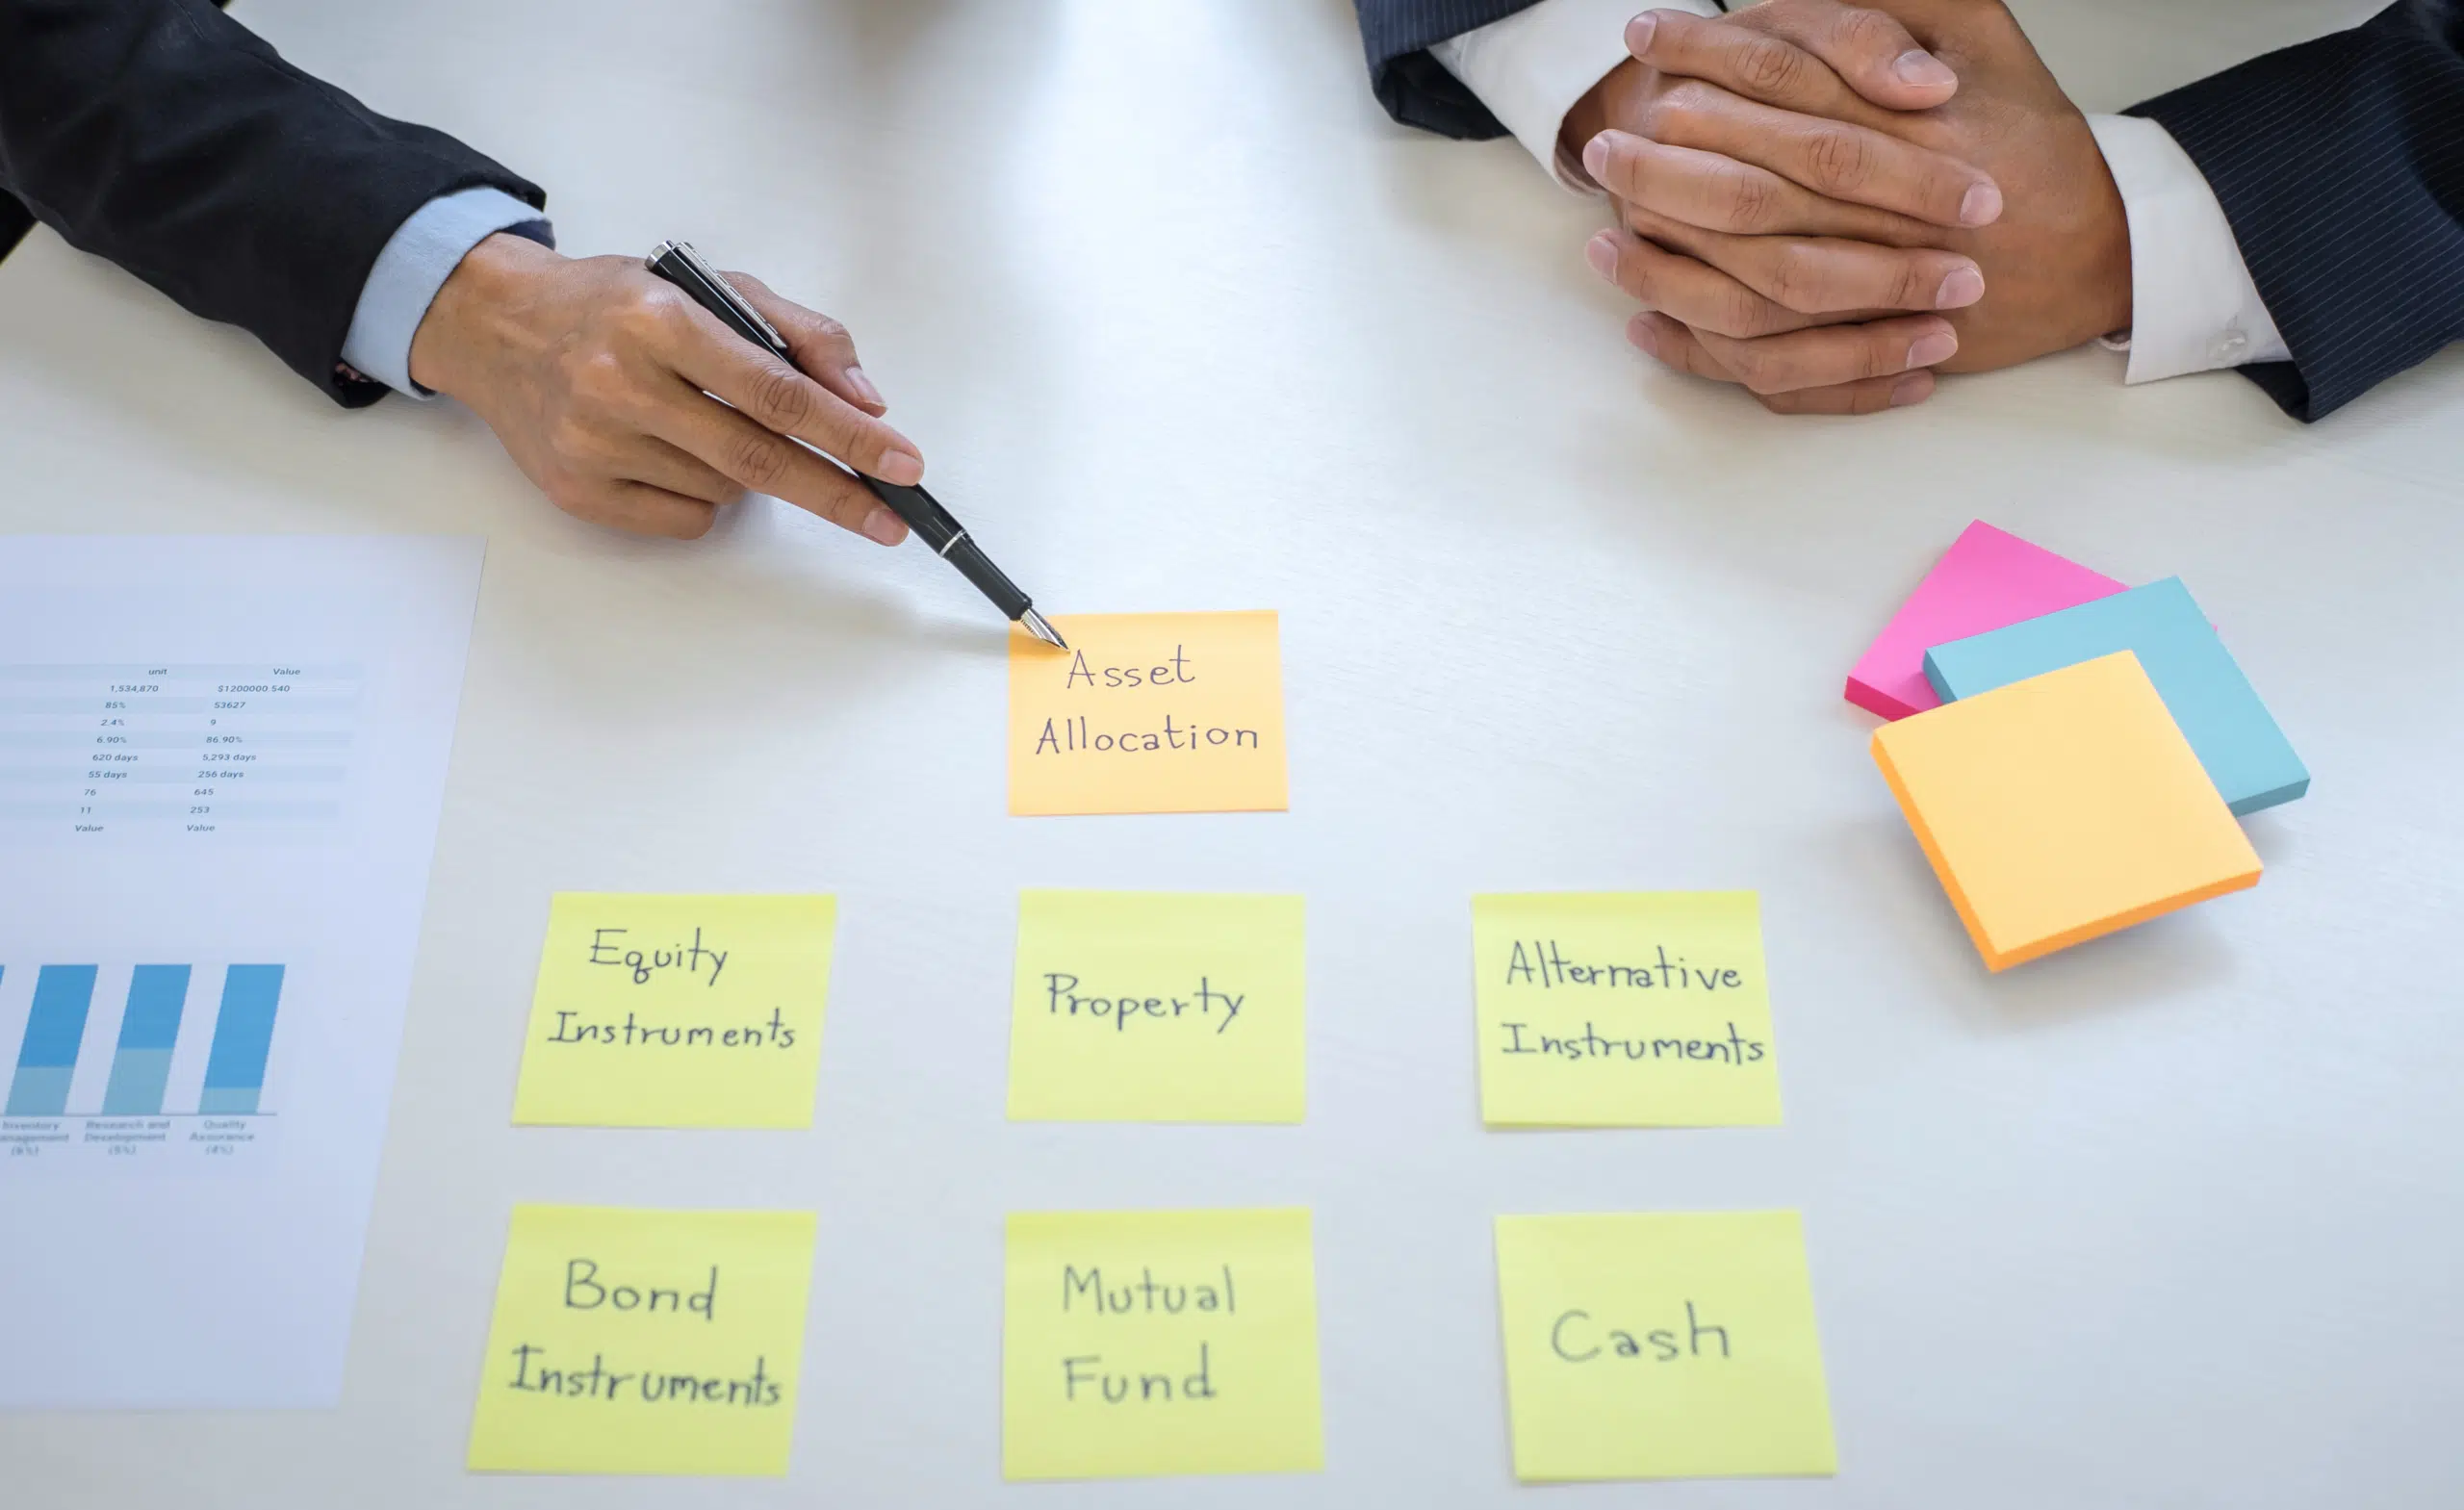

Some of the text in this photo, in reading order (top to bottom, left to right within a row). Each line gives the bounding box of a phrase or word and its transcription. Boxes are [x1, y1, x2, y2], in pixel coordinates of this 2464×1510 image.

[1065, 643, 1196, 690] Asset
[110, 684, 160, 694] 1,534,870
[209, 718, 218, 727] 9
[1036, 714, 1257, 755] Allocation
[88, 770, 128, 781] 55 days
[91, 754, 140, 763] 620 days
[196, 770, 245, 780] 256 days
[232, 754, 257, 763] days
[79, 806, 92, 814] 11
[83, 788, 97, 797] 76
[189, 806, 211, 814] 253
[74, 824, 105, 832] Value
[186, 824, 217, 832] Value
[589, 927, 728, 987] Equity
[1506, 939, 1742, 991] Alternative
[1043, 973, 1245, 1035] Property
[547, 1007, 795, 1049] Instruments
[1501, 1021, 1765, 1066] Instruments
[564, 1259, 718, 1321] Bond
[1064, 1265, 1235, 1315] Mutual
[1552, 1301, 1730, 1362] Cash
[508, 1344, 782, 1407] Instruments
[1063, 1342, 1217, 1403] Fund
